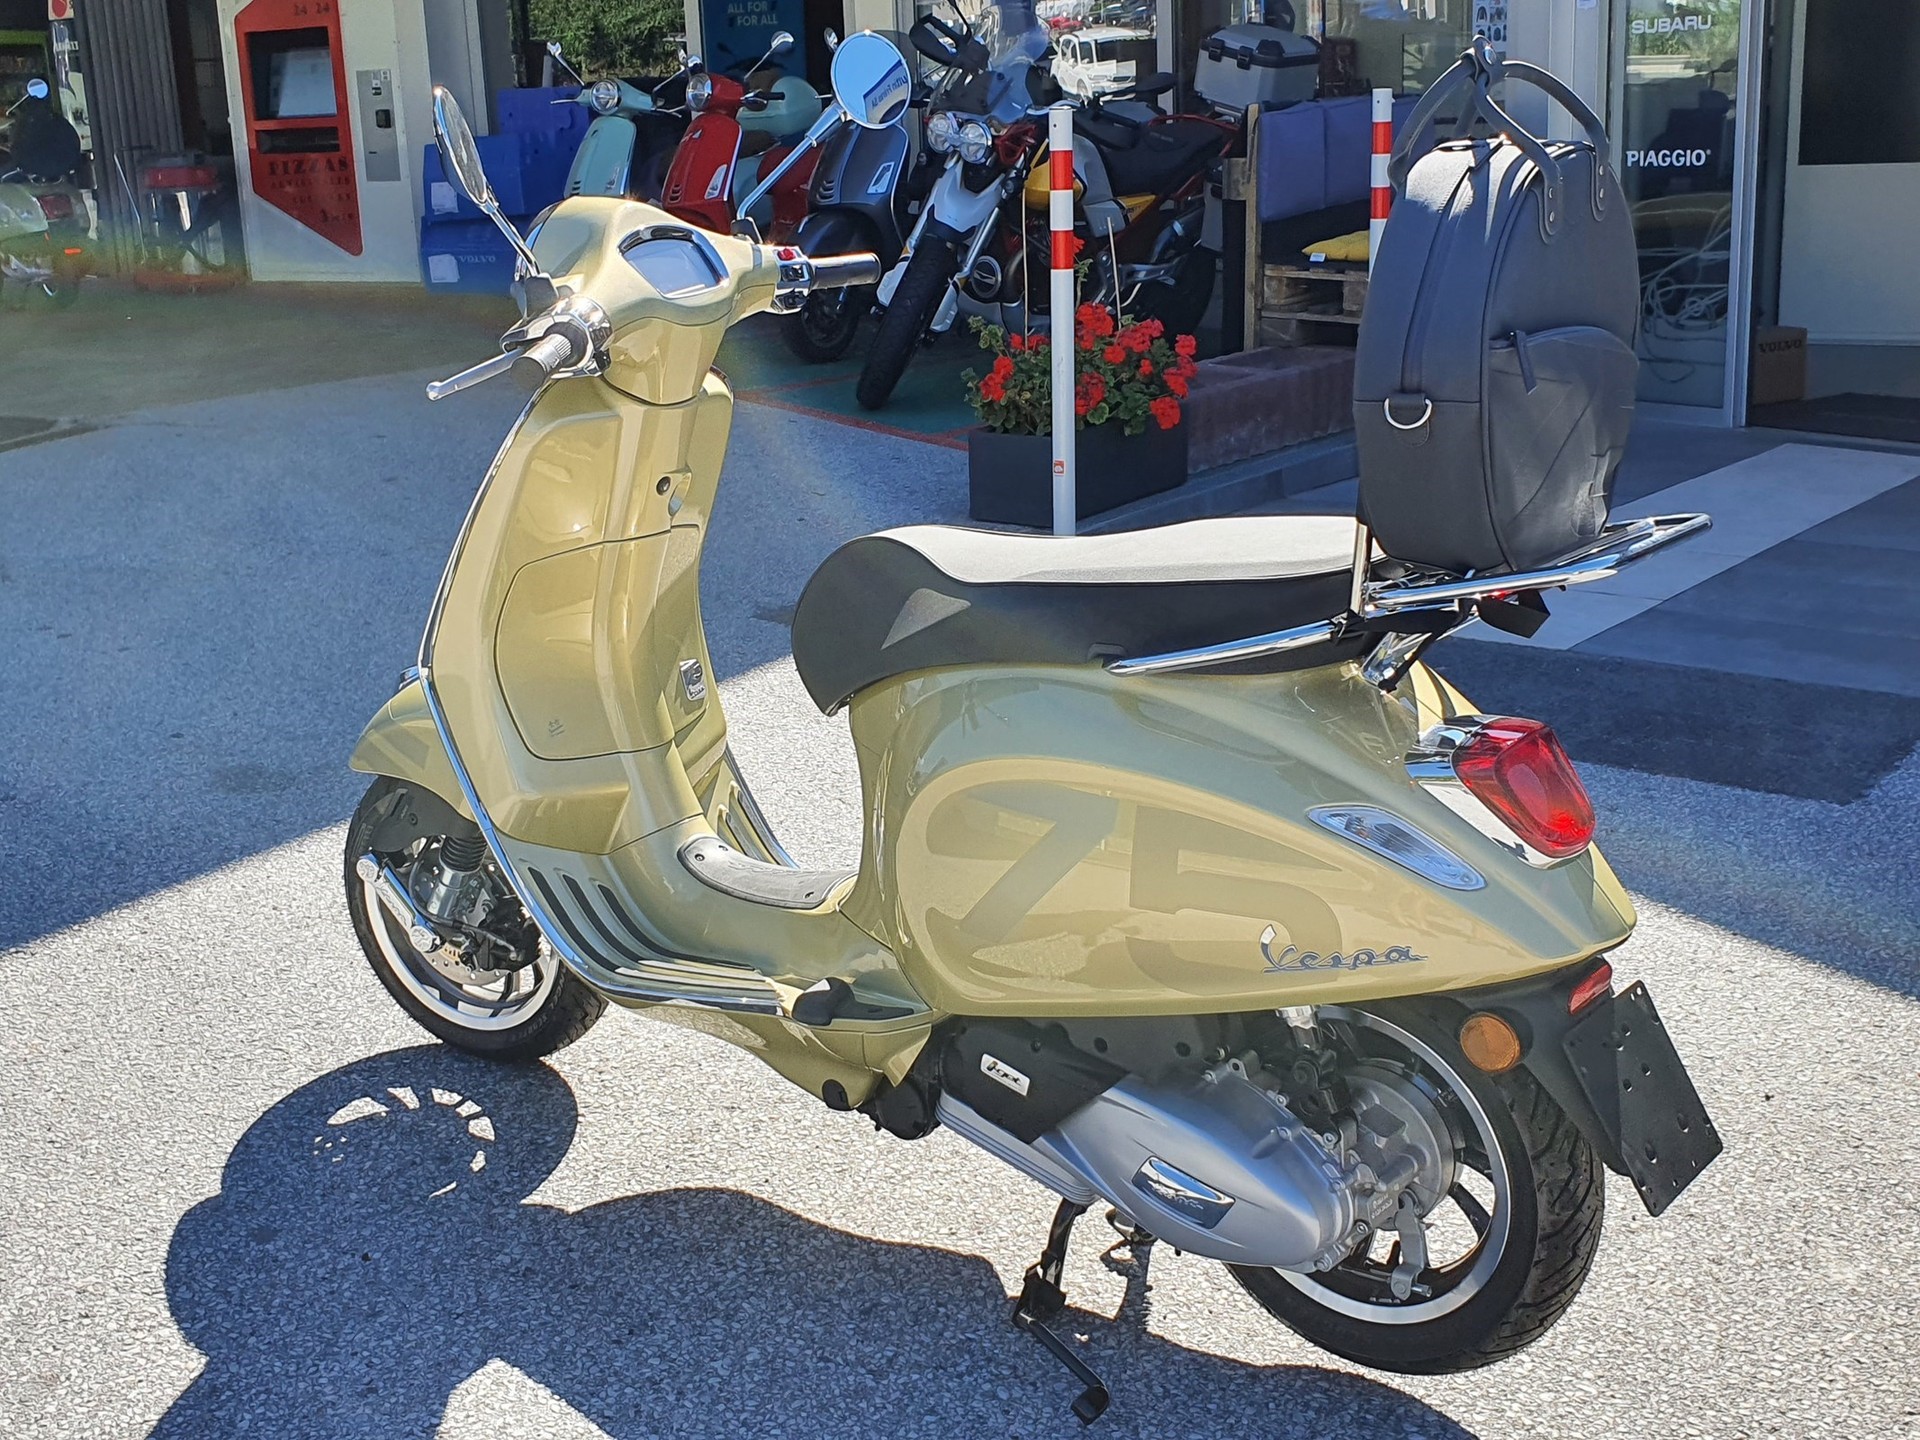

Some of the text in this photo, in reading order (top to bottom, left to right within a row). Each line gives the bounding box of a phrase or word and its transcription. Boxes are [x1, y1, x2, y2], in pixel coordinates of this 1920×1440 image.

[727, 2, 745, 13] ALL
[747, 1, 768, 12] FOR
[737, 15, 758, 26] FOR
[761, 13, 778, 25] ALL
[1631, 14, 1712, 34] SUBARU
[1260, 924, 1429, 974] Vespa
